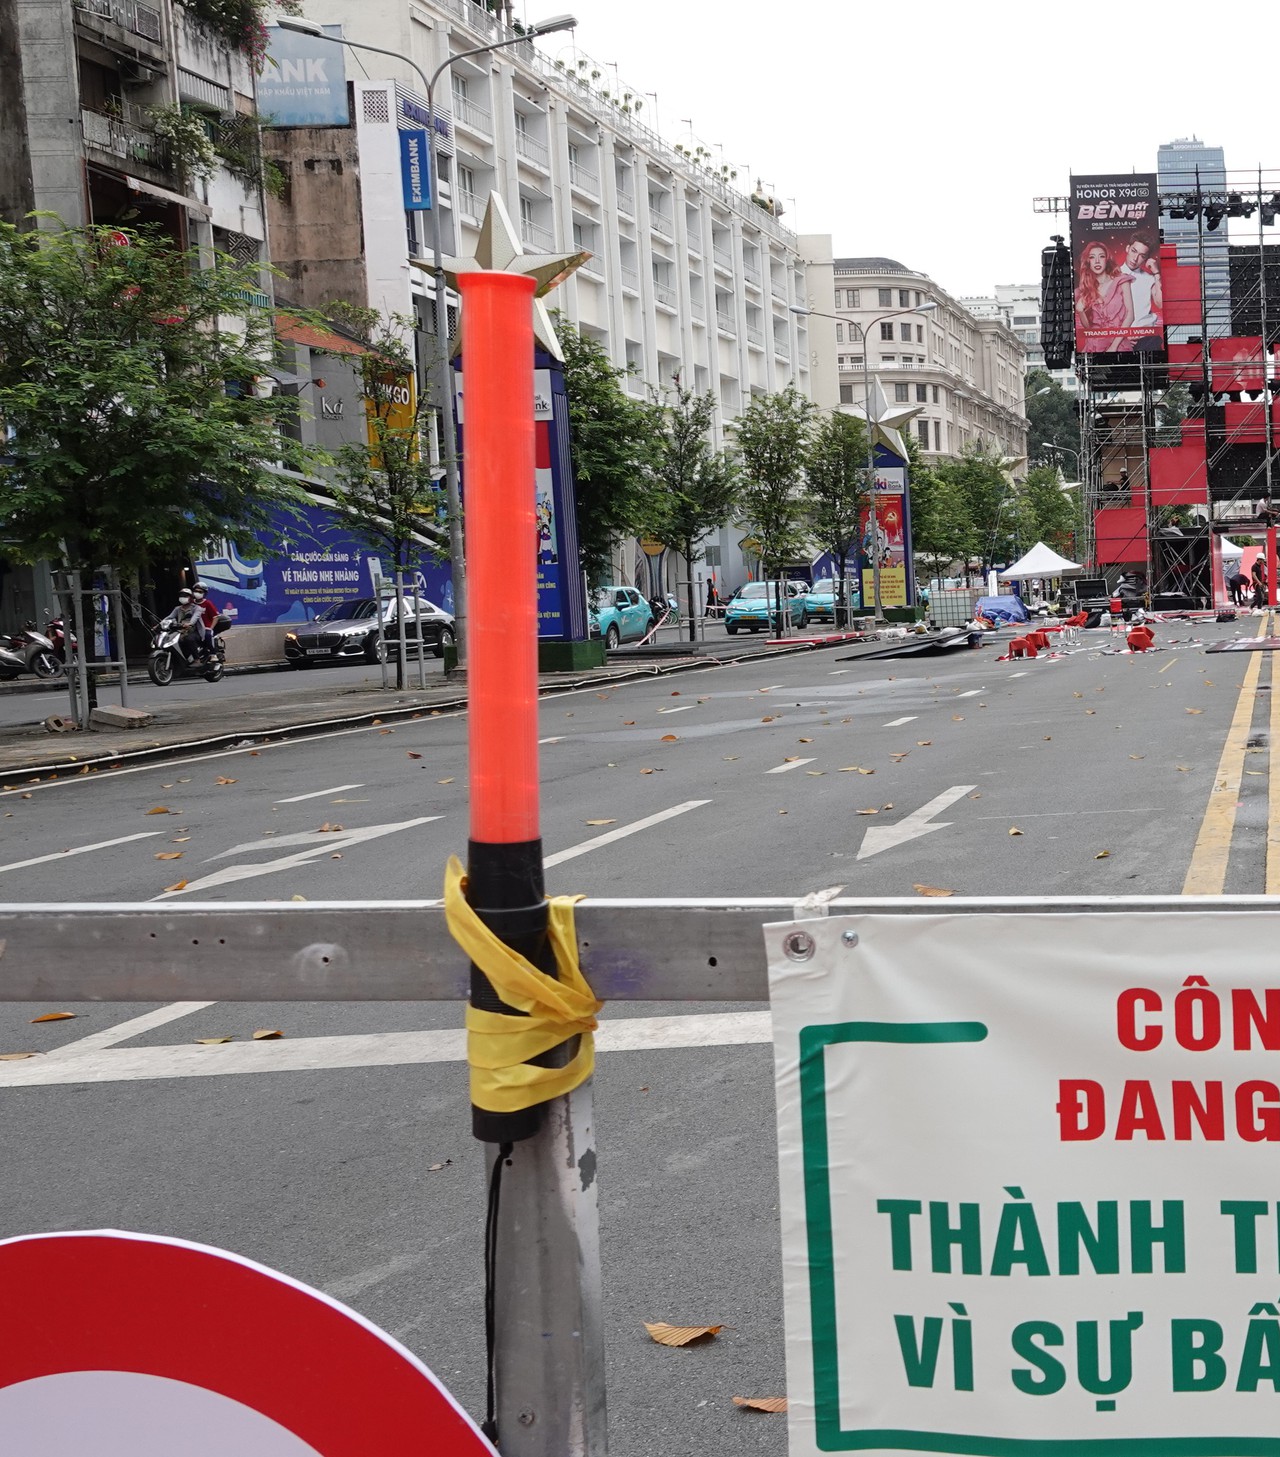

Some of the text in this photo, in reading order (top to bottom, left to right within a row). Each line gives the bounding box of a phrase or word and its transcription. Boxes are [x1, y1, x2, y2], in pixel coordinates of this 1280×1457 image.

[409, 138, 423, 203] EXIMBANK
[1077, 189, 1116, 199] HONOR
[1119, 189, 1136, 197] X9d
[1078, 200, 1128, 219] BỀN
[282, 568, 359, 584] VÉ THÁNG NHẸ NHÀNG
[877, 1186, 1187, 1276] THÀNH
[894, 1302, 975, 1392] VÌ
[1011, 1311, 1144, 1412] SỰ
